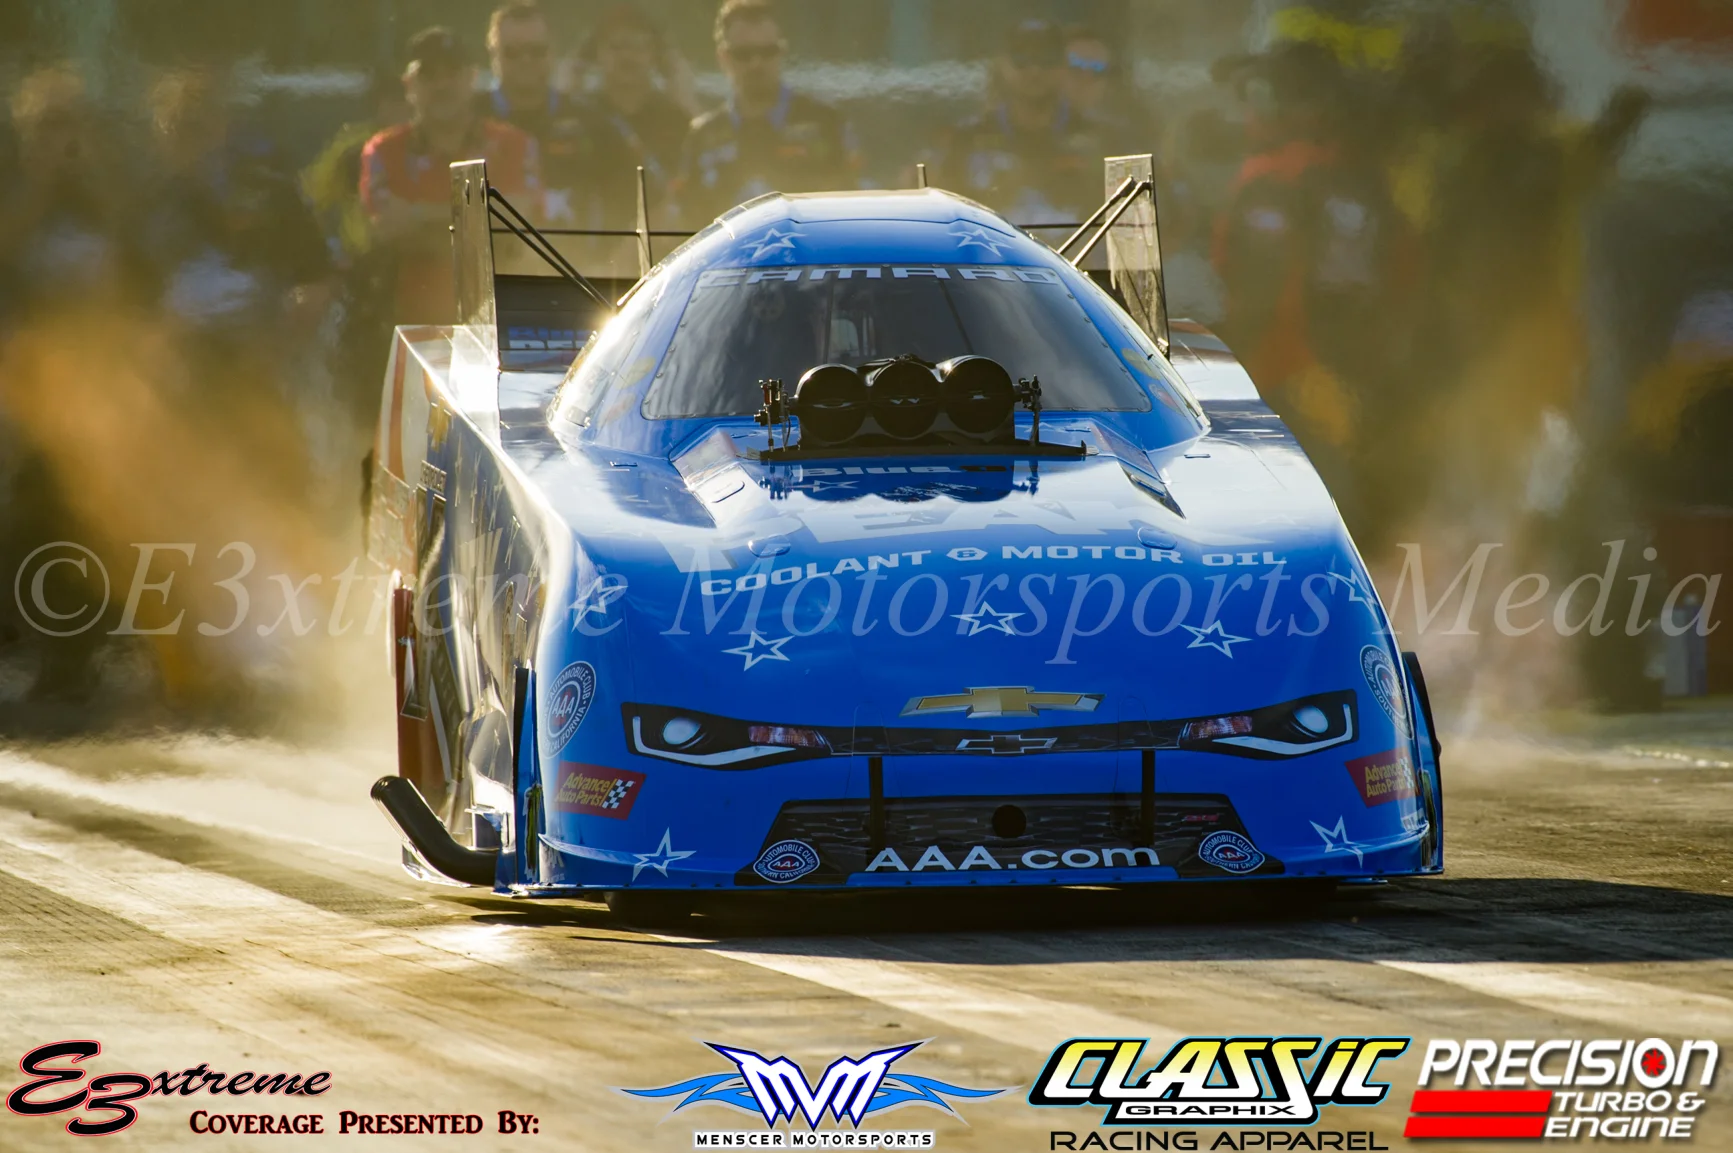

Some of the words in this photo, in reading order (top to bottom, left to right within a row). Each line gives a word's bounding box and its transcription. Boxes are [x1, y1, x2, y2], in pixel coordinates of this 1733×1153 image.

[699, 266, 1057, 287] CAMARO
[701, 550, 932, 595] COOLANT
[1002, 545, 1184, 564] MOTOR
[1202, 551, 1287, 566] OIL
[549, 666, 588, 700] AUTOMOBILE
[582, 675, 592, 701] CLUB
[552, 694, 575, 718] AAA
[549, 706, 587, 753] CALIFORNIA
[562, 772, 611, 793] Advance
[1366, 782, 1387, 798] Auto
[575, 790, 603, 807] Parts
[764, 843, 803, 863] AUTOMOBILE
[1203, 834, 1237, 855] AUTOMOBILE
[772, 860, 800, 868] AAA
[865, 844, 1160, 873] AAA.com
